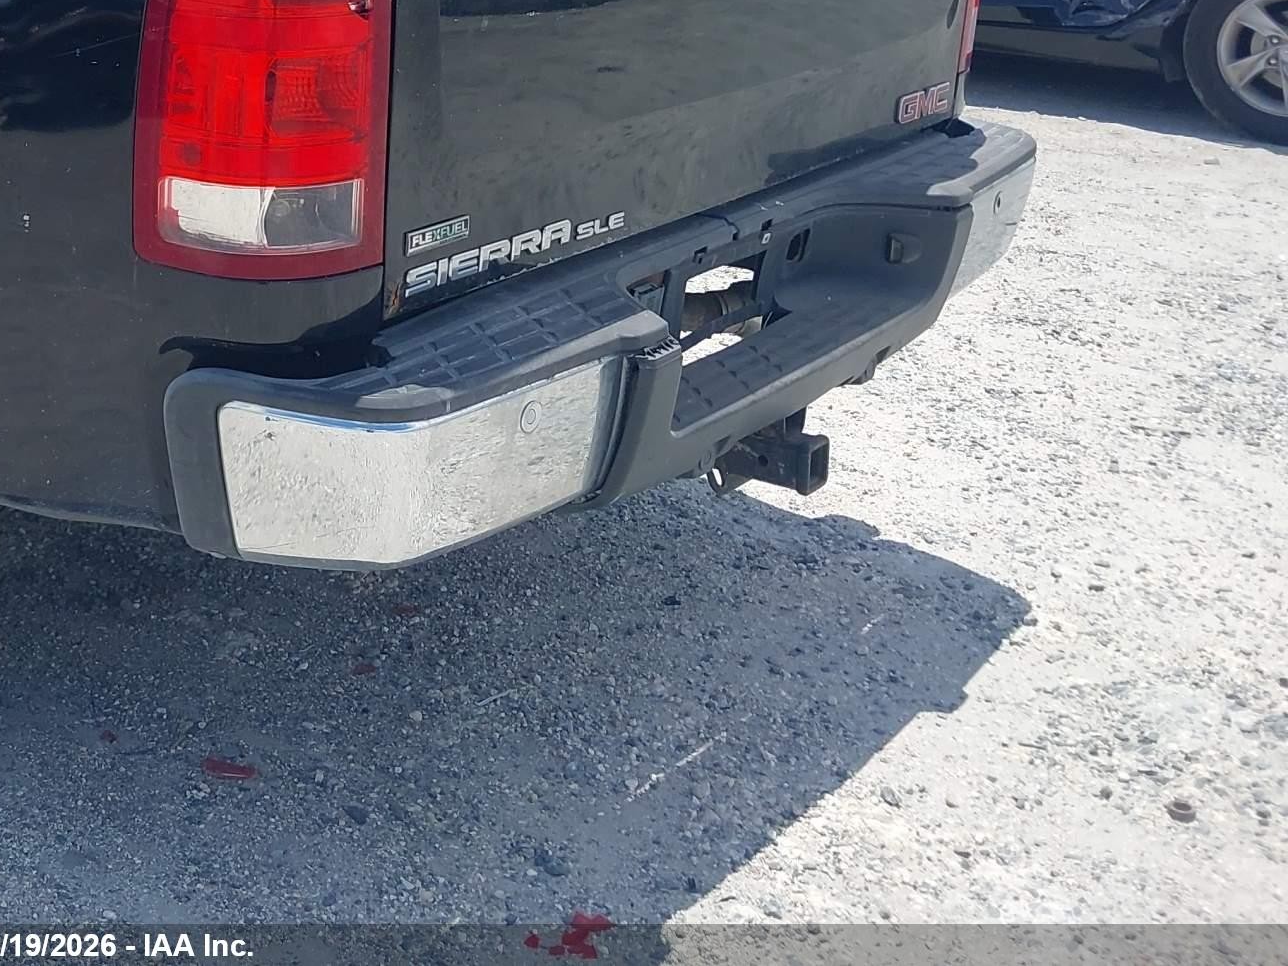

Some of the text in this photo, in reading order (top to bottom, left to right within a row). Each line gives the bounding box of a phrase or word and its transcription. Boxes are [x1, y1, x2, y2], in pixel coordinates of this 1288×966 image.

[898, 81, 951, 124] GMC
[405, 211, 626, 298] SIERRA SLE
[411, 221, 469, 248] FLEXFUEL
